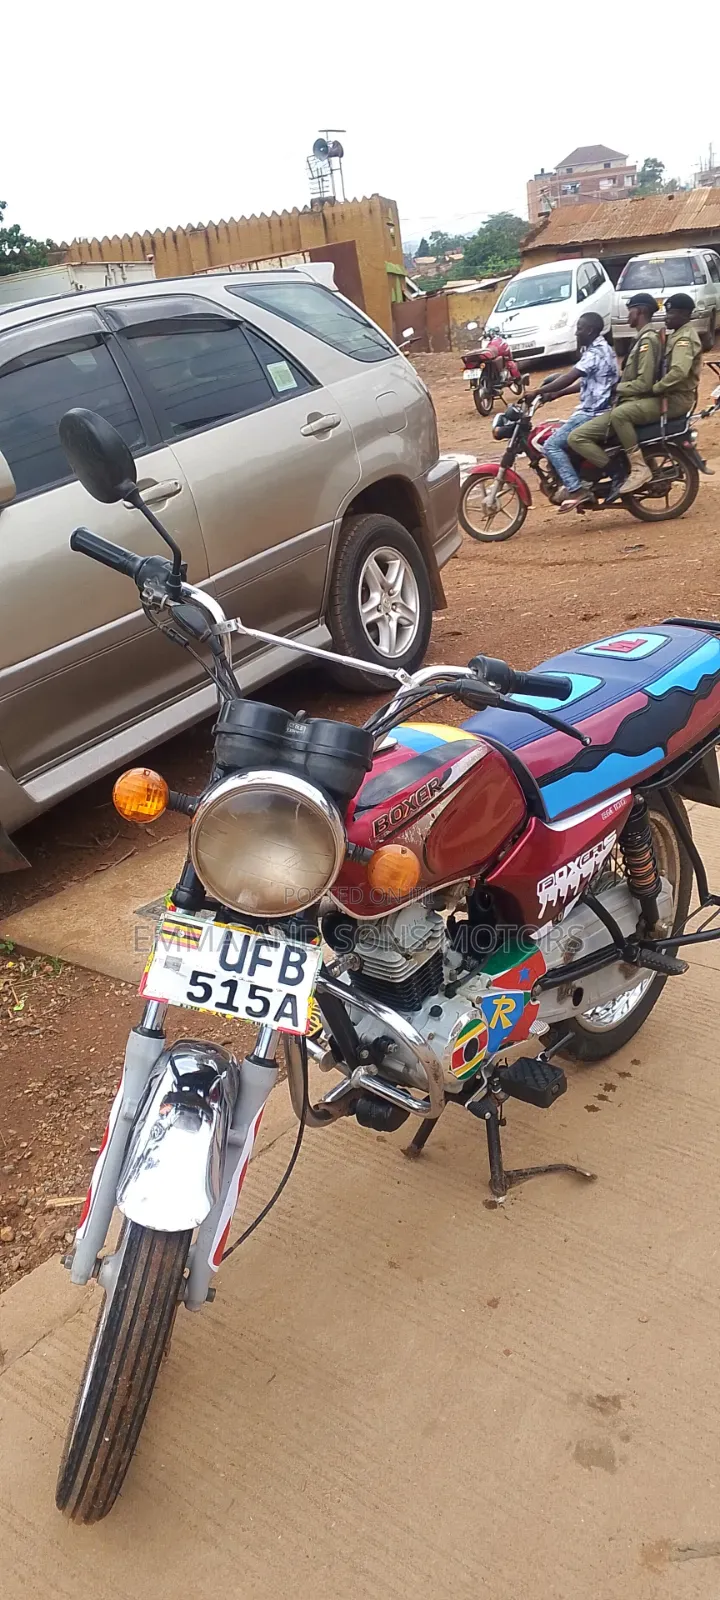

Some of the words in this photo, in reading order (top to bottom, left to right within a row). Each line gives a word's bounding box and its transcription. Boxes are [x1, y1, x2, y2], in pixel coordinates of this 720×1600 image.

[372, 777, 444, 838] BOXER
[219, 930, 307, 986] UFB
[186, 970, 299, 1027] 515A
